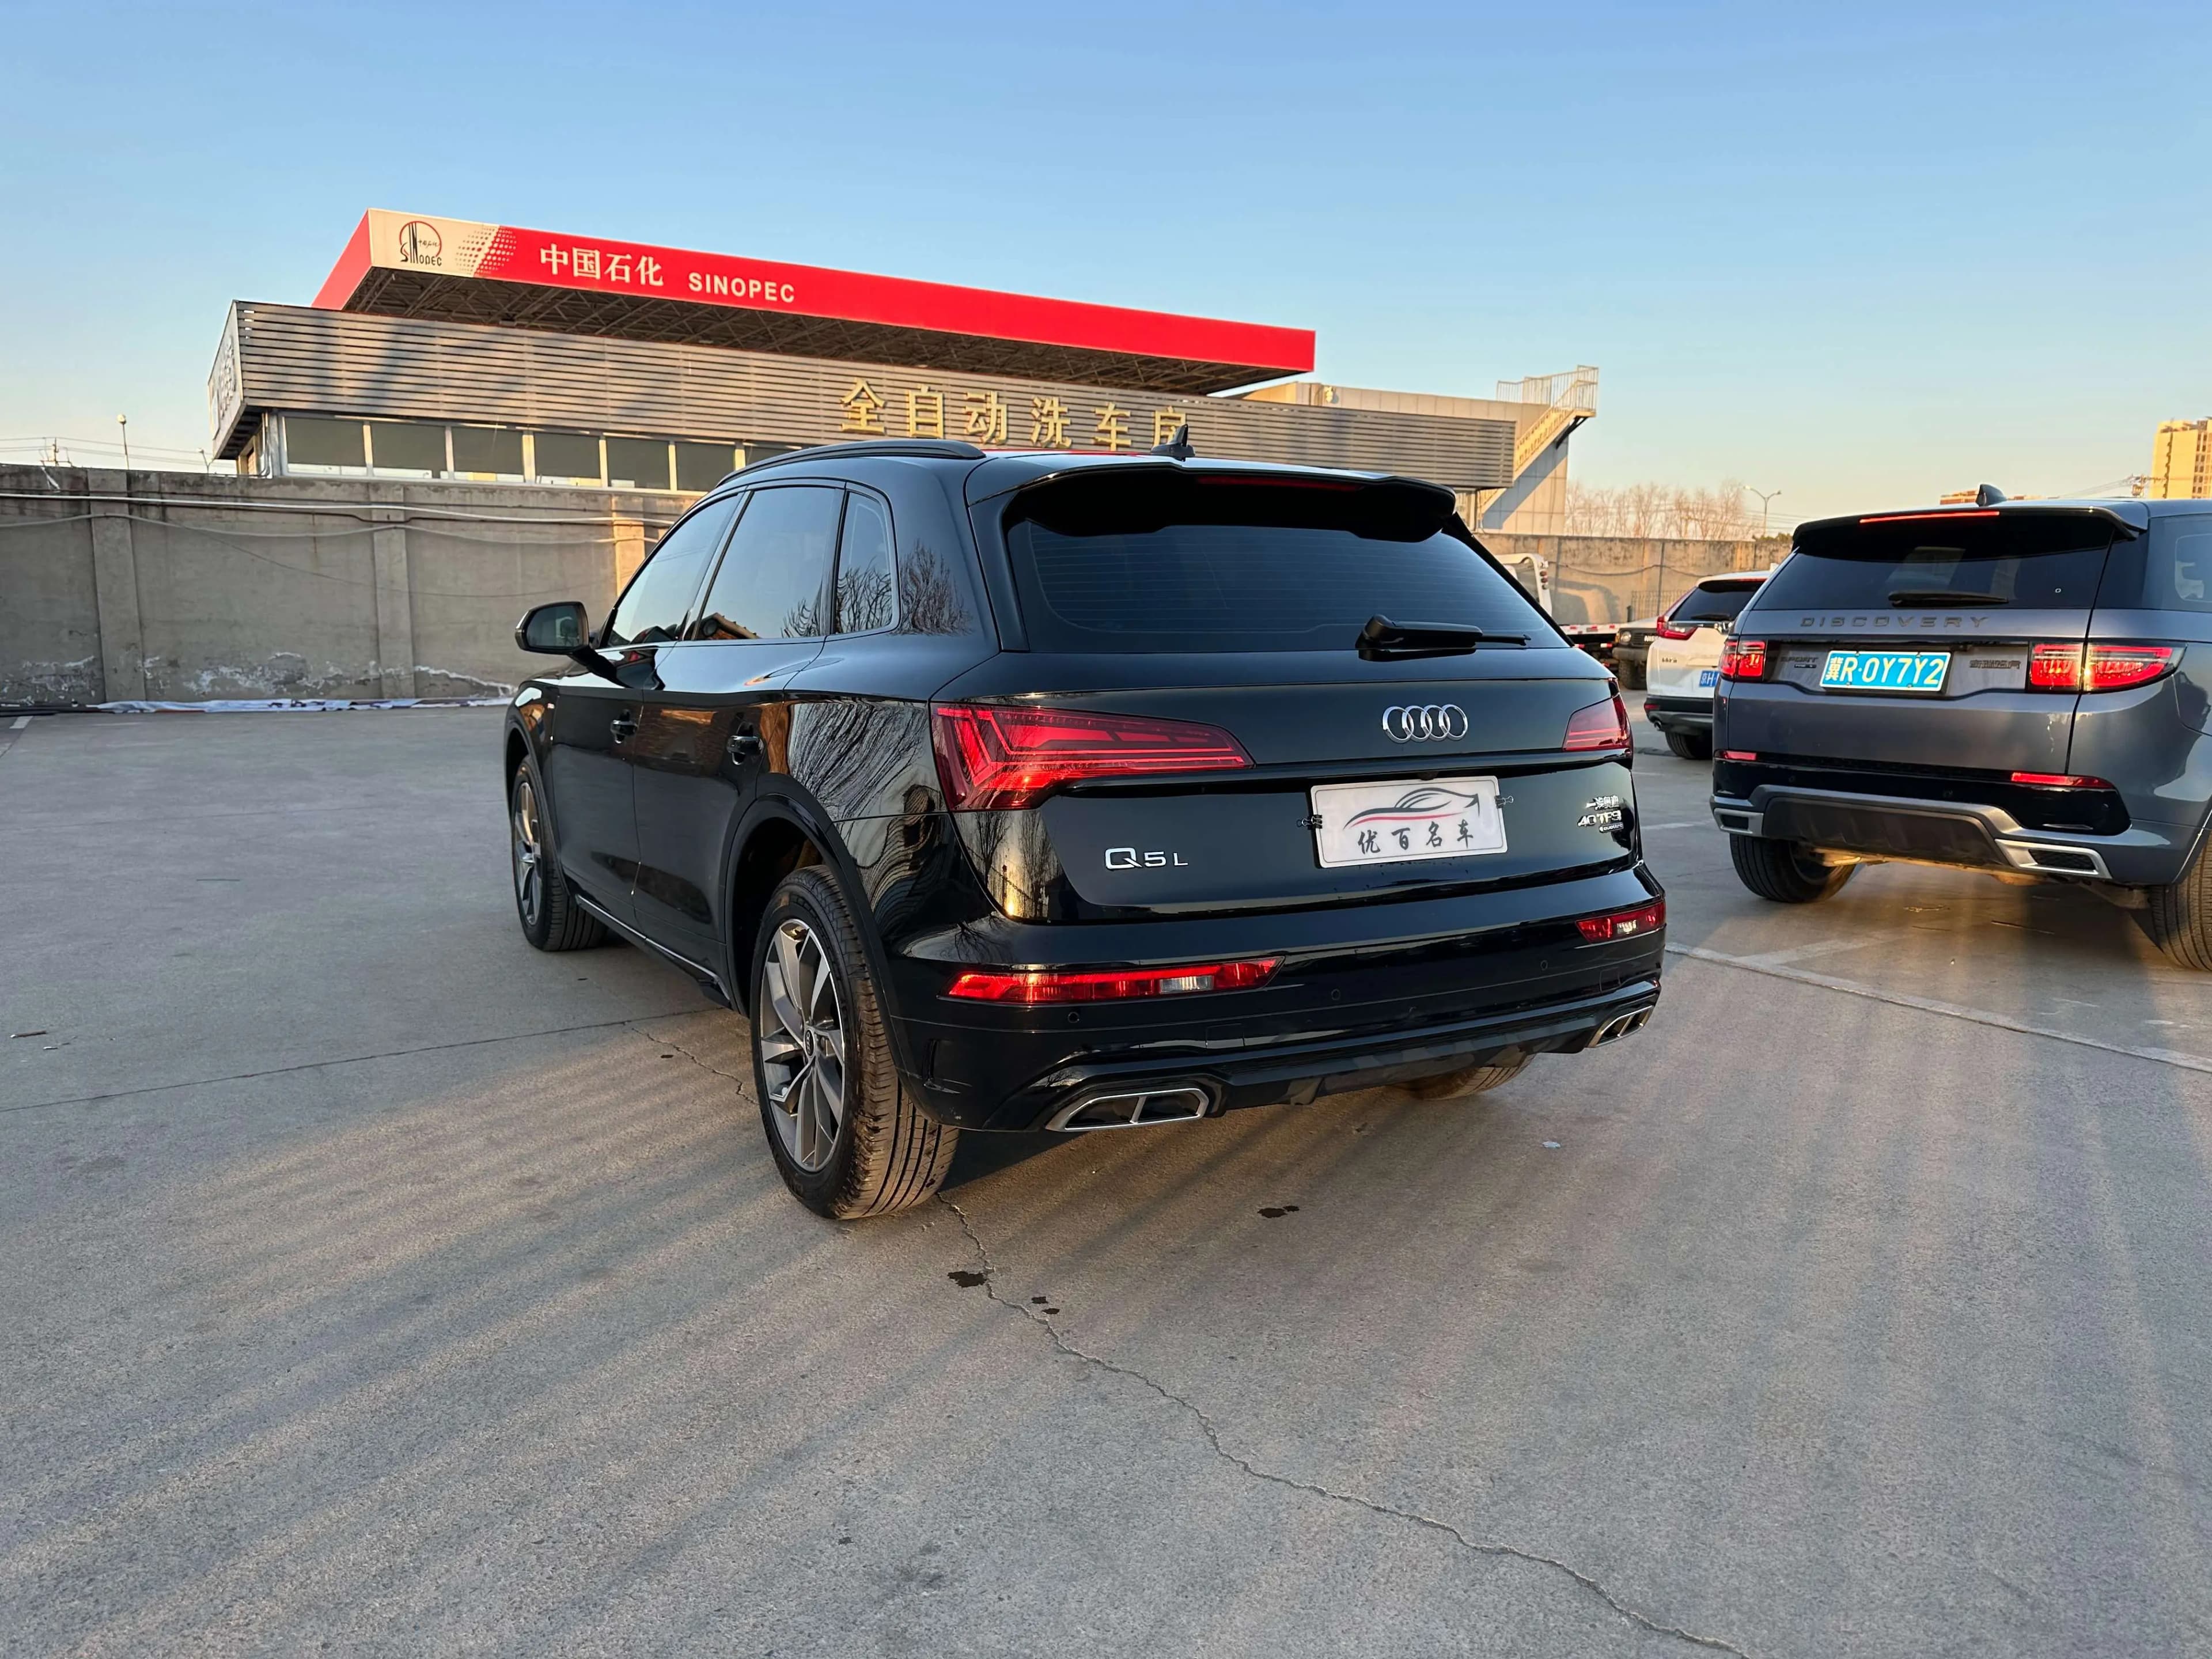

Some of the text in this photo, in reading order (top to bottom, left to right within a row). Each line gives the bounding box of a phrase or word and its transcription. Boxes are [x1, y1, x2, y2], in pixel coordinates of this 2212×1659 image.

[540, 244, 664, 287] 中国石化
[688, 272, 795, 304] SINOPEC
[1800, 616, 1988, 628] DISCOVERY
[1358, 819, 1474, 854] 优百名车
